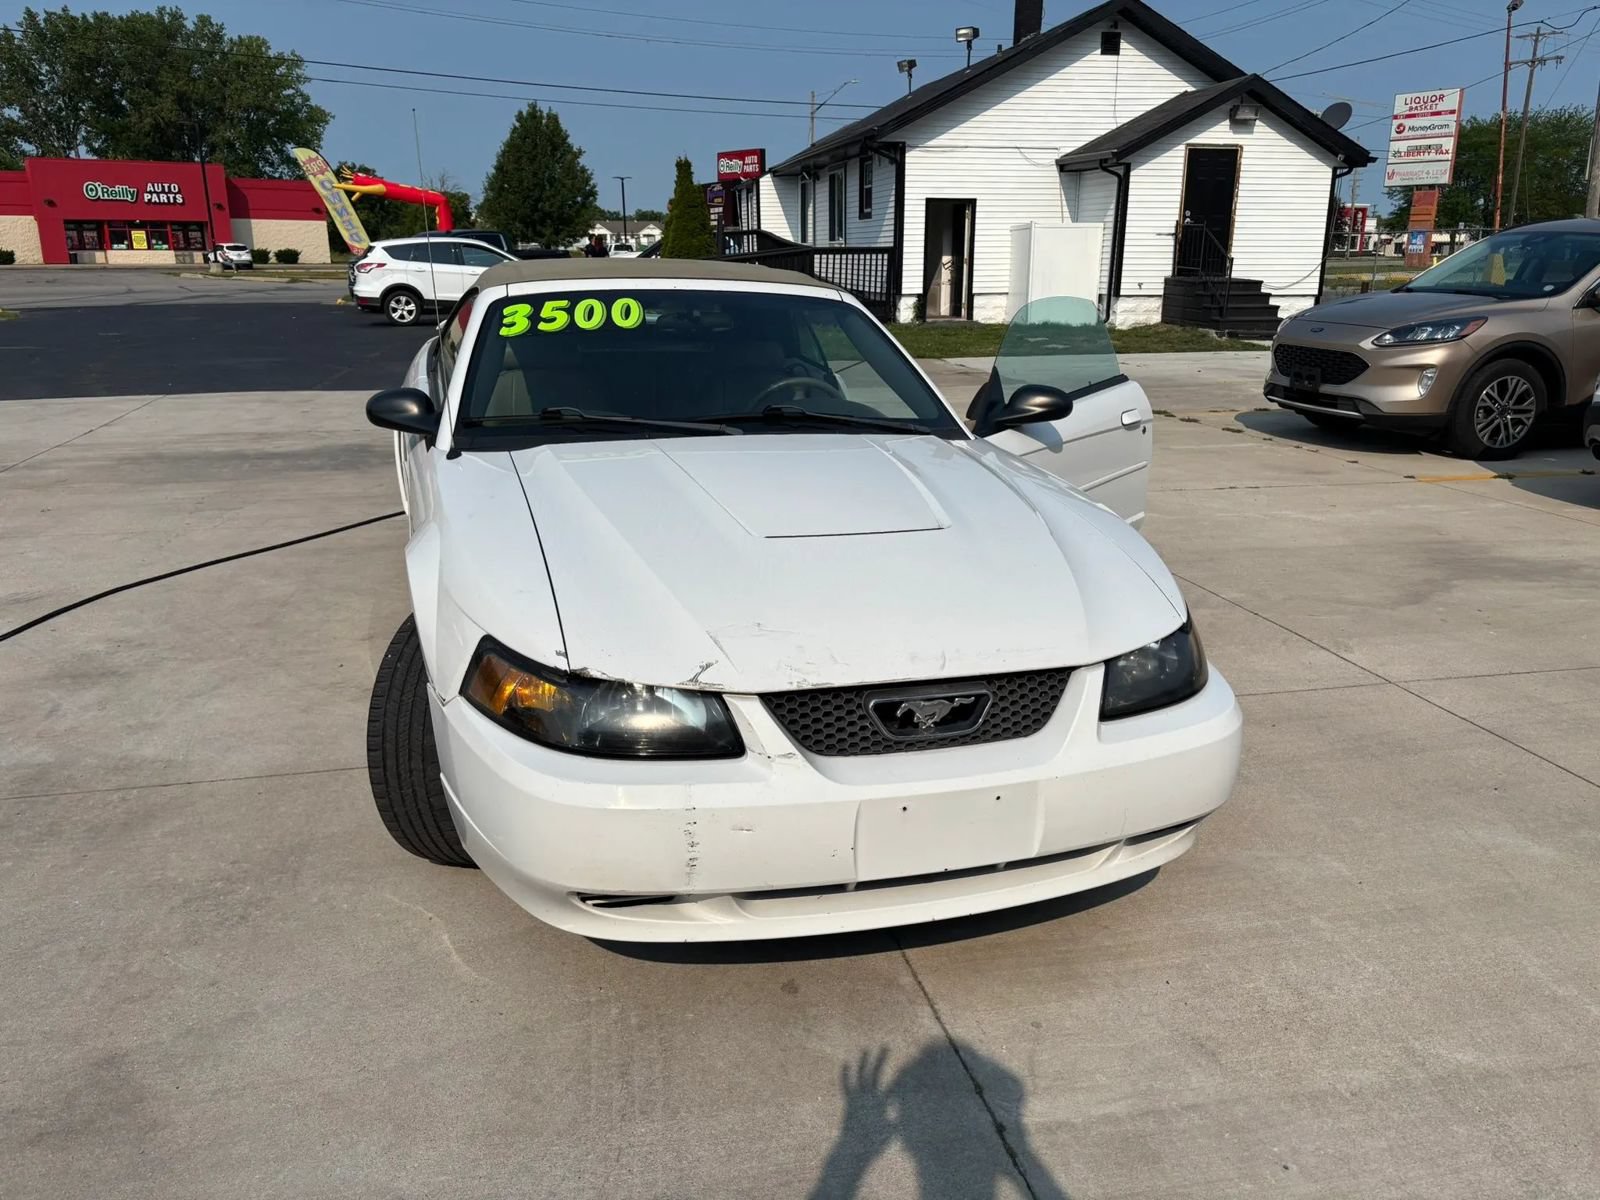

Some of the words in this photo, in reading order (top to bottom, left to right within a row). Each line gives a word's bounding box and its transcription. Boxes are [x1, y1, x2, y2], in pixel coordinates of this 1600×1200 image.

[1404, 94, 1445, 105] LIQUOR
[1408, 103, 1438, 112] BASKET
[1407, 123, 1450, 133] MoneyGram
[1399, 148, 1431, 158] LIBERTY
[1434, 148, 1450, 156] TAX
[745, 155, 758, 164] AUTO
[719, 158, 743, 174] O'Reilly
[743, 164, 759, 173] PARTS
[83, 181, 137, 202] O'Reilly
[147, 183, 179, 193] AUTO
[144, 193, 183, 203] PARTS
[499, 297, 644, 337] 3500
